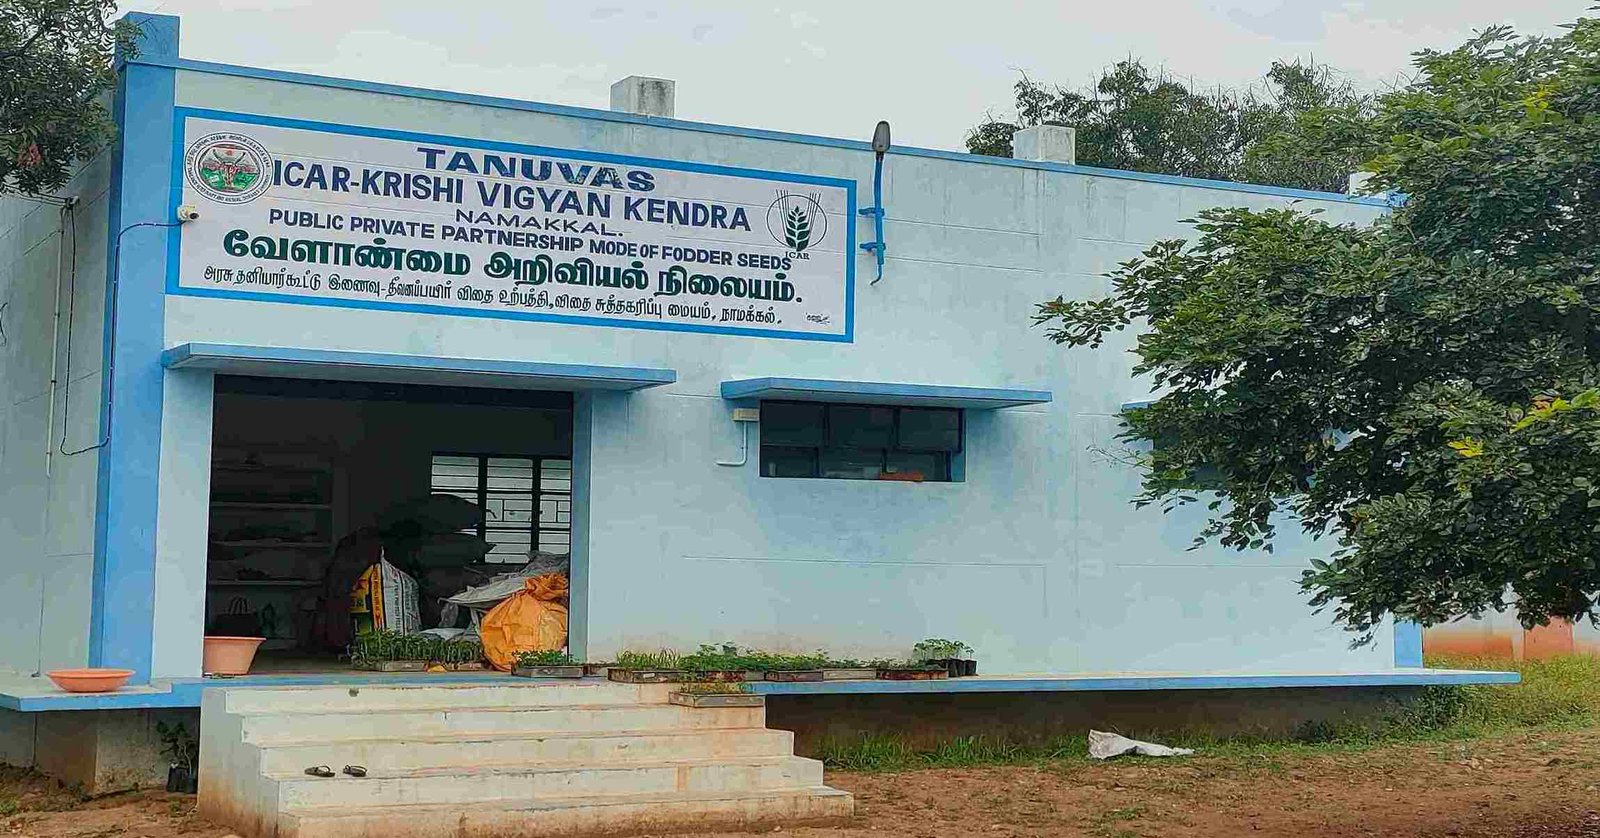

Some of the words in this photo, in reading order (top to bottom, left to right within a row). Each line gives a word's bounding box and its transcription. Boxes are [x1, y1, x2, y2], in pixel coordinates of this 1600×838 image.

[417, 147, 655, 191] TANUVAS
[273, 160, 463, 204] ICAR-KRISHI
[477, 181, 610, 218] VIGYAN
[624, 196, 751, 231] KENDRA
[270, 208, 343, 230] PUBLIC
[350, 216, 434, 239] PRIVATE
[441, 225, 584, 251] PARTNERSHIP
[589, 241, 637, 258] MODE
[640, 244, 659, 259] OF
[662, 246, 732, 266] FODDER
[737, 253, 791, 271] SEEDS
[456, 209, 623, 236] NAMAKKAL.
[223, 229, 471, 276] வேளாண்மை
[484, 251, 648, 289] அறிவியல்
[654, 265, 802, 303] நிலையம்.
[785, 250, 810, 260] ICAR
[457, 285, 493, 304] விதை
